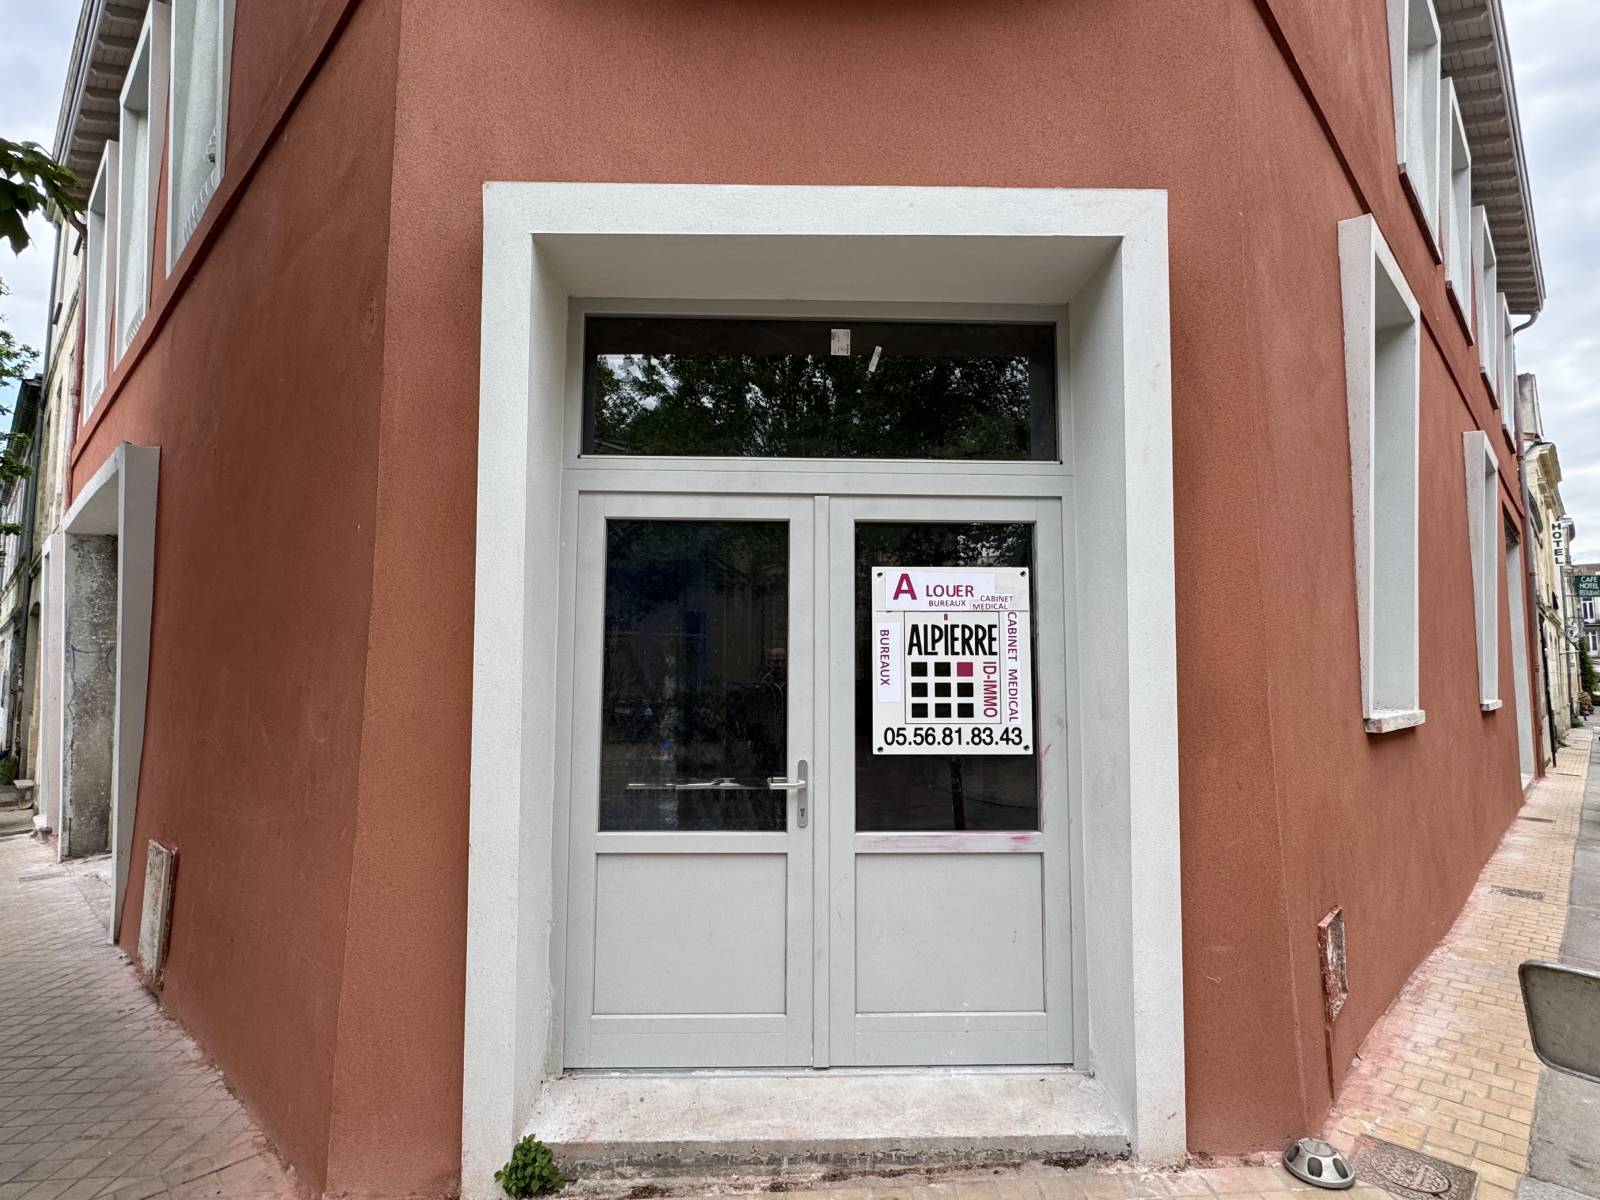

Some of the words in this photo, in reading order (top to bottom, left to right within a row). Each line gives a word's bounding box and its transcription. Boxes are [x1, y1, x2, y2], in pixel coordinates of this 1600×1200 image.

[1552, 523, 1563, 564] HOTEL
[893, 573, 917, 600] A
[926, 585, 974, 597] LOUER
[980, 595, 1013, 603] CABINET
[907, 624, 998, 656] ALPIERRE
[1007, 611, 1018, 662] CABINET
[879, 629, 890, 686] BUREAUX
[983, 661, 998, 718] ID-IMMO
[1008, 669, 1019, 722] MEDICAL
[883, 727, 1023, 746] 05.56.81.83.43
